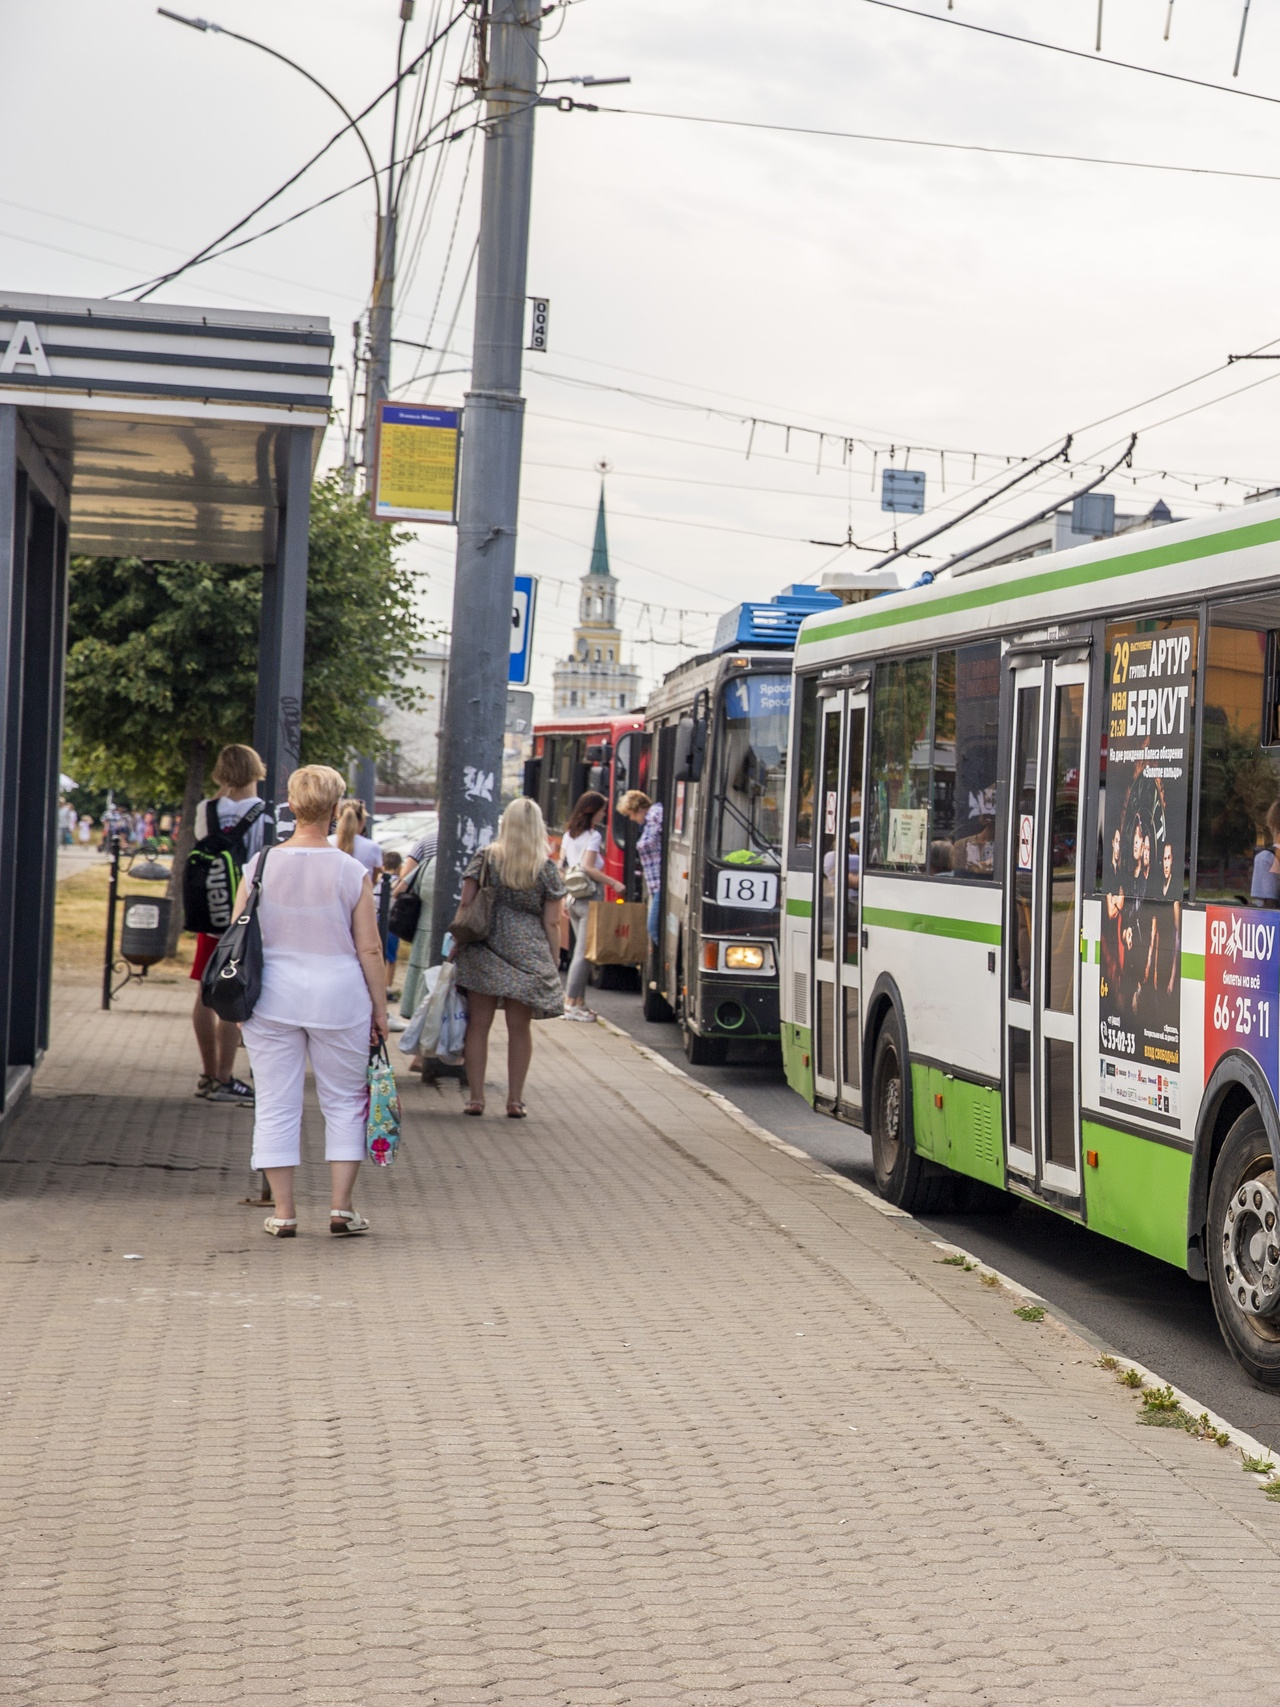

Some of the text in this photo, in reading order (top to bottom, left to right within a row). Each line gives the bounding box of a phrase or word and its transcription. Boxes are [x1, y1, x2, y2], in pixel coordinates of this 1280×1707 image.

[535, 302, 546, 348] 0049
[1112, 641, 1130, 685] 29
[1129, 664, 1148, 680] ГРУППЫ
[1148, 635, 1192, 678] АРТУР
[1126, 685, 1190, 737] БЕРКУТ
[1109, 718, 1127, 738] 21:30
[1123, 750, 1145, 764] рождения
[206, 857, 230, 928] arena
[723, 877, 770, 902] 181
[1242, 923, 1275, 961] ШОУ
[1100, 976, 1109, 997] 6+
[1222, 970, 1261, 990] билеты на всё
